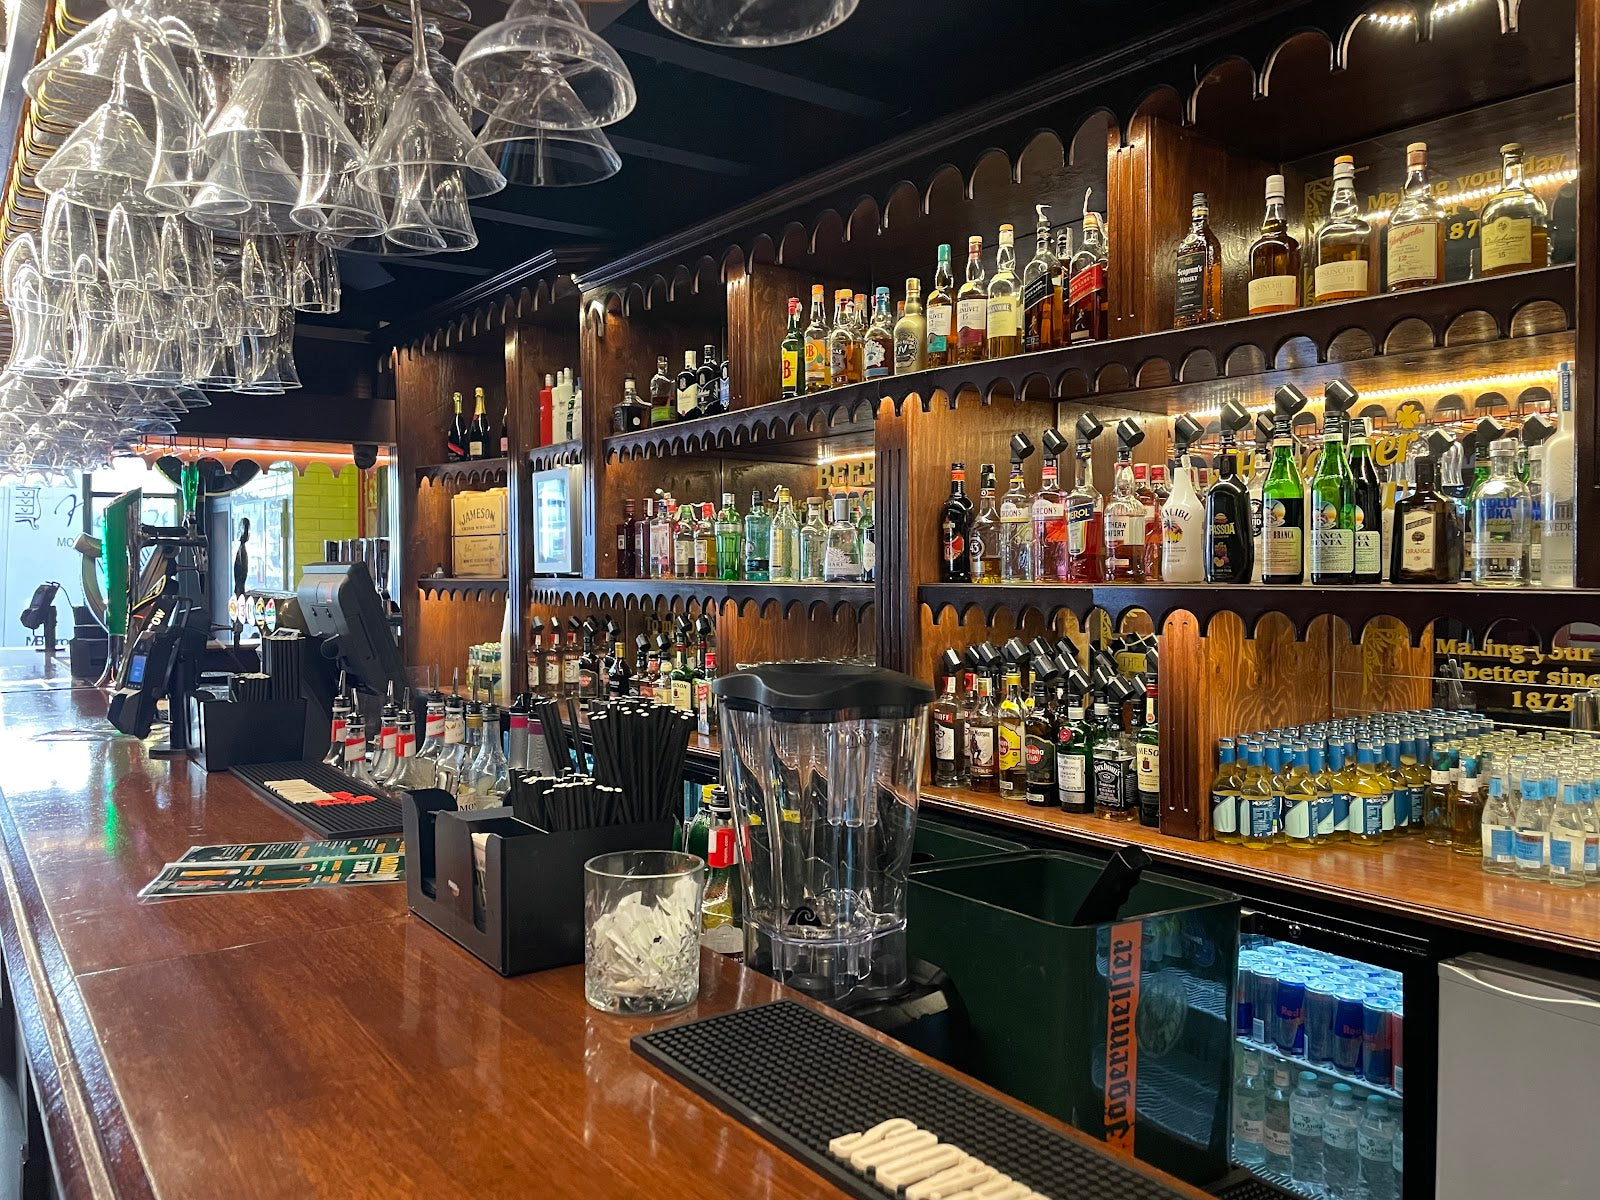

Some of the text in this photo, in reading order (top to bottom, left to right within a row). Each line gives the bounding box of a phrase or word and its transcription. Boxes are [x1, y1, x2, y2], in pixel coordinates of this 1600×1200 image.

[1524, 154, 1566, 175] day
[460, 508, 495, 525] JAMESON
[1463, 662, 1600, 689] better sinc
[1511, 691, 1575, 712] 1873
